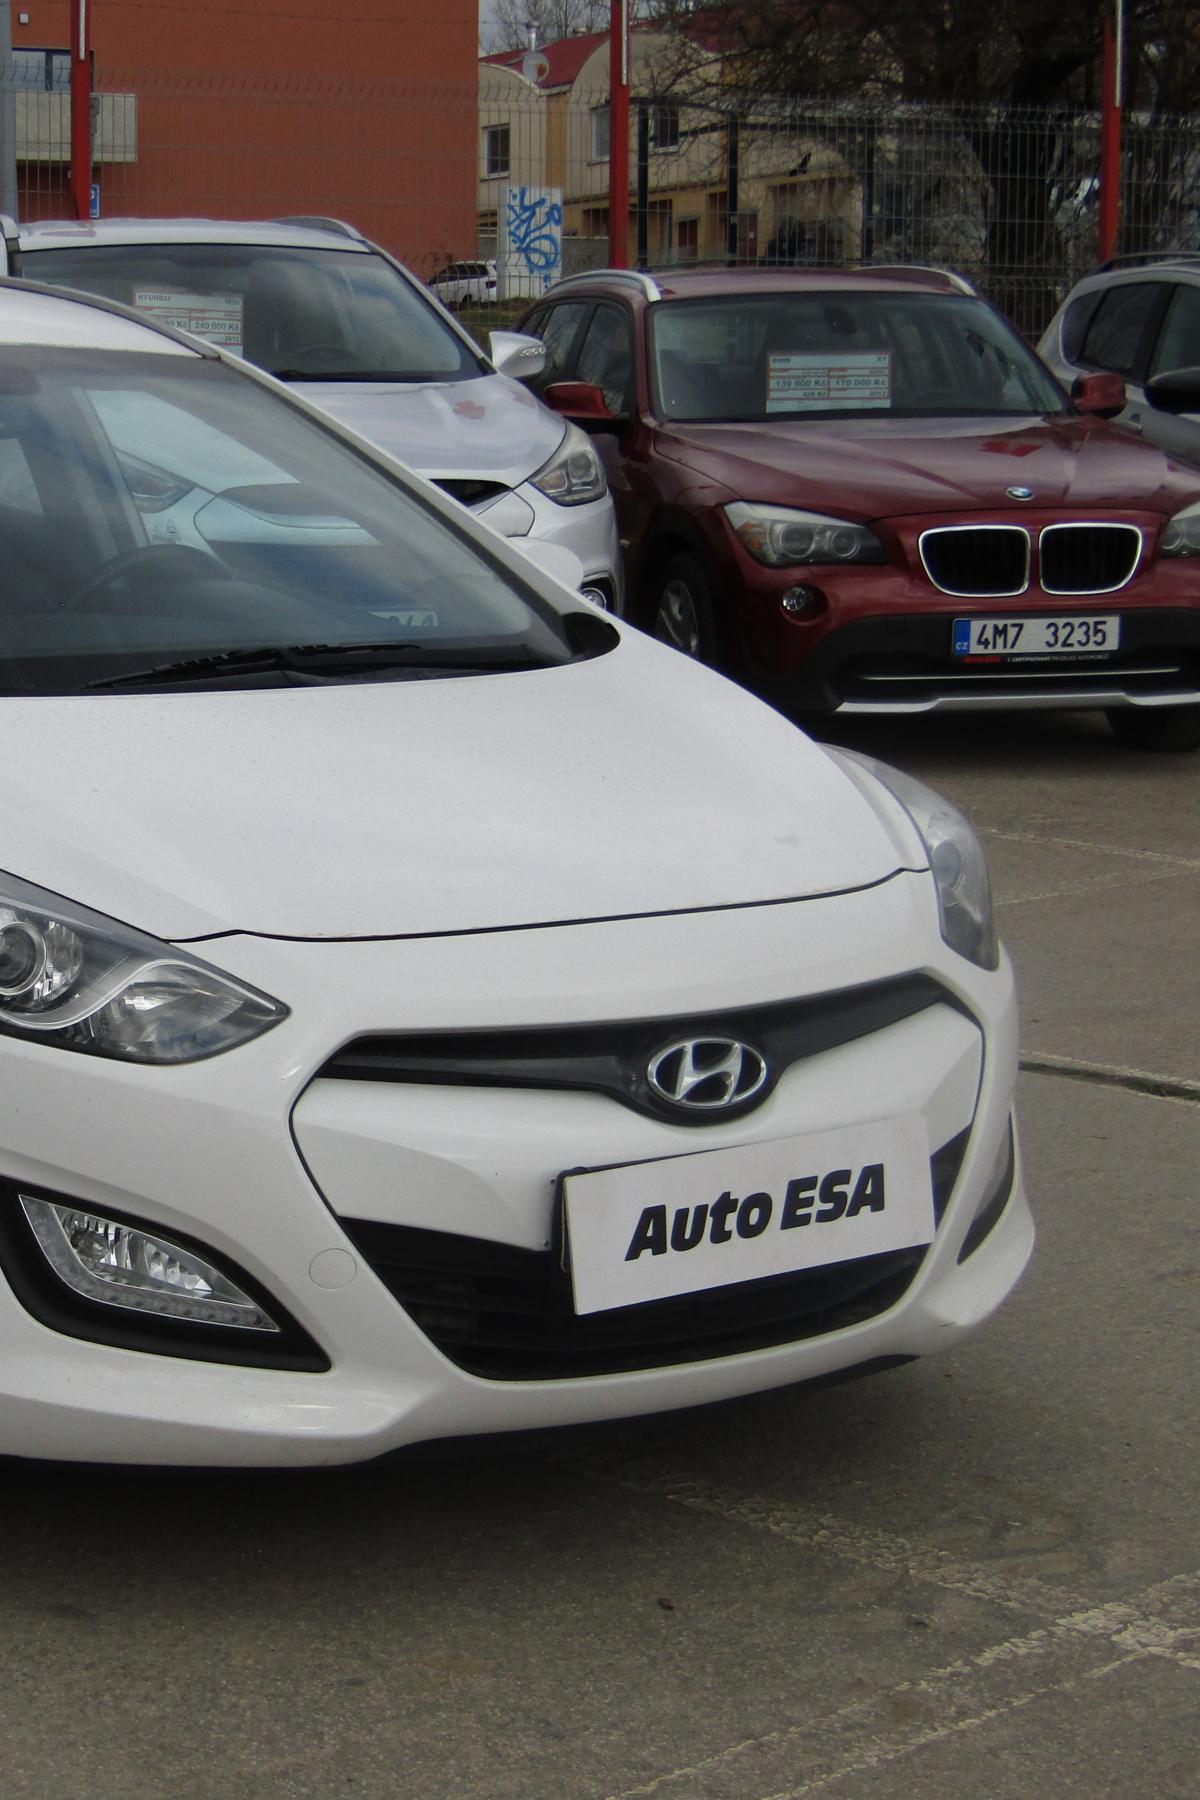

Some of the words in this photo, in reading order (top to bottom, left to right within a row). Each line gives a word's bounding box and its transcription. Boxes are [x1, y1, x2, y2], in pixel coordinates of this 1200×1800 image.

[138, 294, 171, 302] HYUNDAI
[211, 322, 226, 330] 000
[228, 322, 240, 331] Kč
[814, 379, 826, 387] Kč
[874, 378, 886, 386] Kč
[976, 622, 1025, 650] 4M7
[1044, 620, 1107, 648] 3235
[955, 642, 968, 650] CZ
[624, 1191, 773, 1262] Auto
[780, 1162, 885, 1231] ESA
